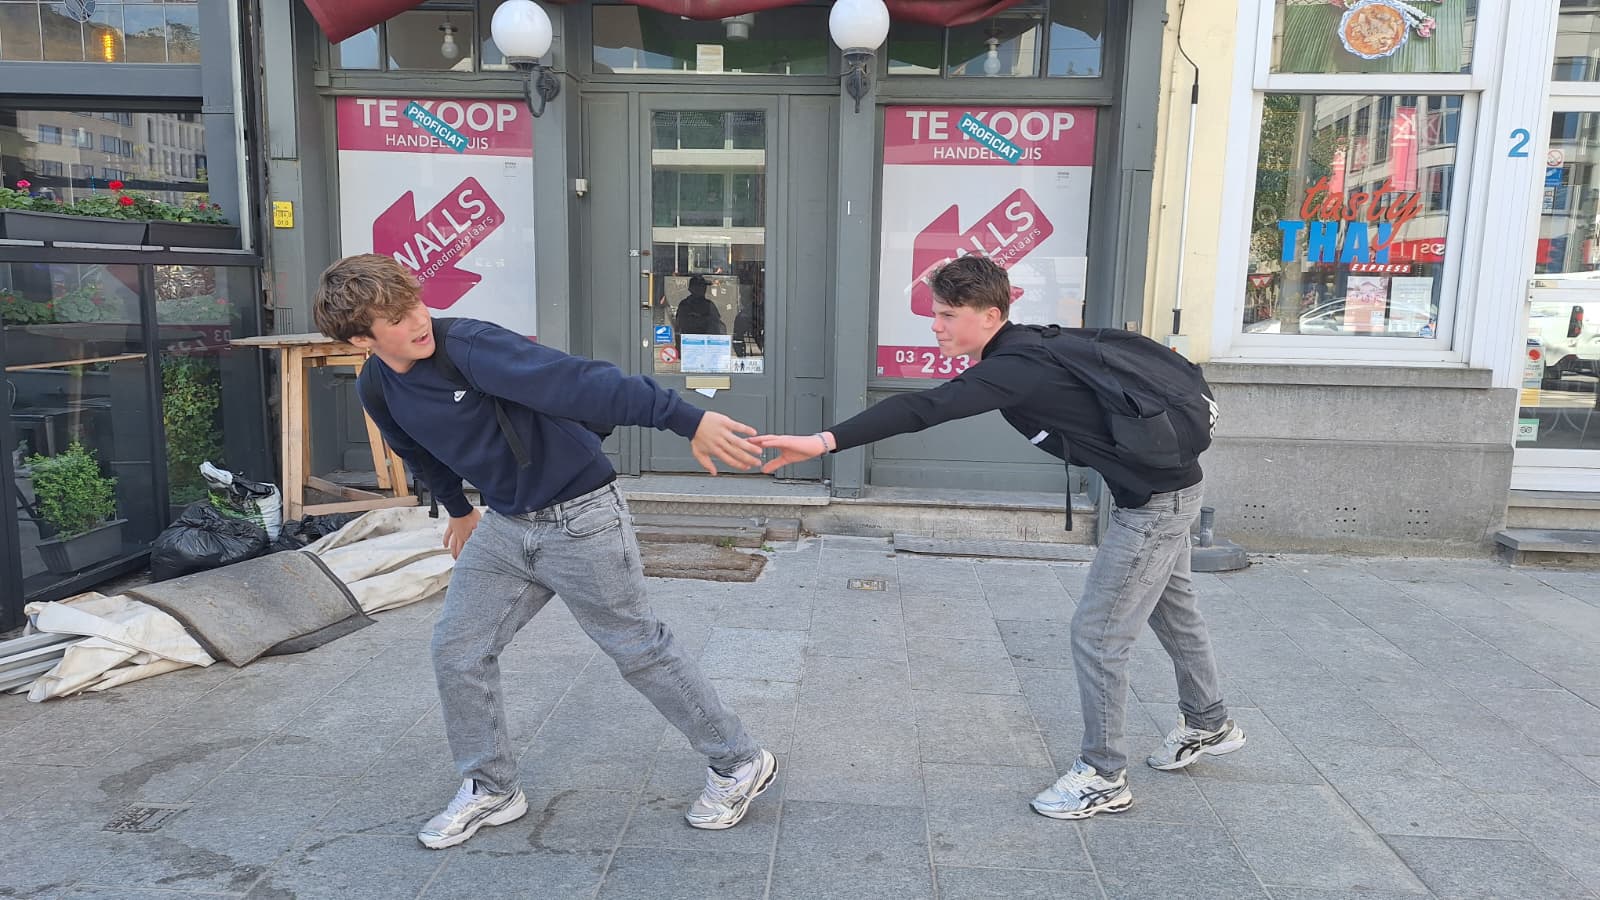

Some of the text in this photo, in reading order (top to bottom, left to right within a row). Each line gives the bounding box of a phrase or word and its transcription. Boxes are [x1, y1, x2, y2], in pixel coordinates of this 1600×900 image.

[356, 98, 399, 128] TE
[408, 105, 465, 149] PROFICIAT
[905, 111, 949, 140] TE
[386, 134, 489, 150] HANDELUIS
[934, 146, 1042, 160] HANDELUIS
[961, 118, 1019, 160] PROFICIAT
[1507, 128, 1531, 157] 2
[1299, 175, 1423, 251] tasty
[418, 216, 494, 283] stgoedmakelaars
[1277, 219, 1392, 264] THAI
[1351, 263, 1409, 272] EXPRESS
[895, 350, 915, 363] 03
